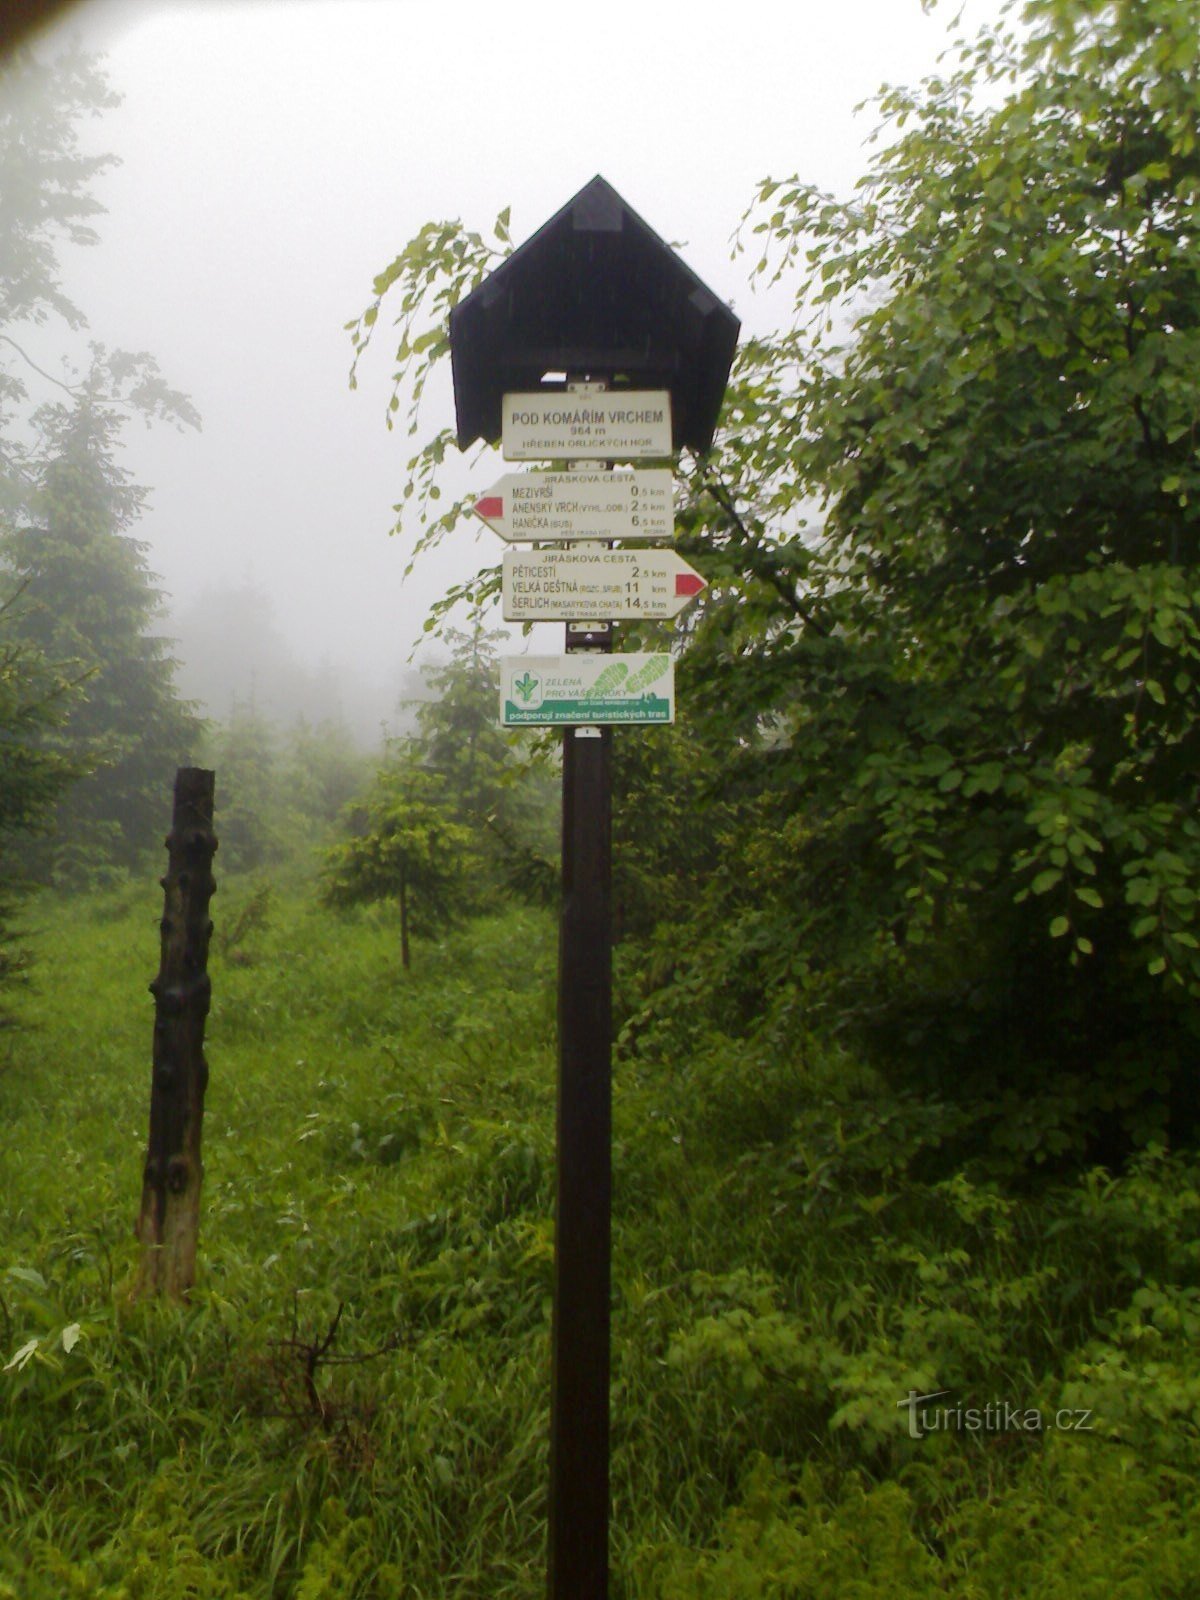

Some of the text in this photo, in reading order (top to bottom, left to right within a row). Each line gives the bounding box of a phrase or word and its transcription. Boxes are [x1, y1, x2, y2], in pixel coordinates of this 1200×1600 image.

[512, 409, 664, 425] POD KOMÁŘÍM VRCHEM
[570, 426, 591, 435] 964
[522, 438, 653, 448] HŘEBEN ORLICKÝCH HOR
[543, 474, 636, 484] JIRÁSKOVA CESTA
[512, 485, 553, 499] MEZIVRŠÍ
[650, 488, 665, 496] km
[512, 500, 552, 513] ANENSKÝ
[554, 501, 578, 513] VRCH
[650, 503, 666, 511] km
[650, 518, 666, 526] km
[542, 553, 637, 563] JIRÁSKOVA CESTA
[512, 564, 556, 578] PĚTICESTÍ
[652, 569, 667, 578] km
[512, 579, 541, 593] VELKÁ
[543, 579, 578, 593] DEŠTNÁ
[624, 581, 639, 593] 11
[652, 585, 667, 593] km
[512, 594, 550, 609] ŠERLICH
[652, 600, 667, 609] km
[545, 676, 582, 687] ZELENÁ
[545, 689, 566, 698] PRO
[509, 711, 553, 721] podporují
[555, 711, 590, 719] značení
[592, 709, 647, 720] turistických
